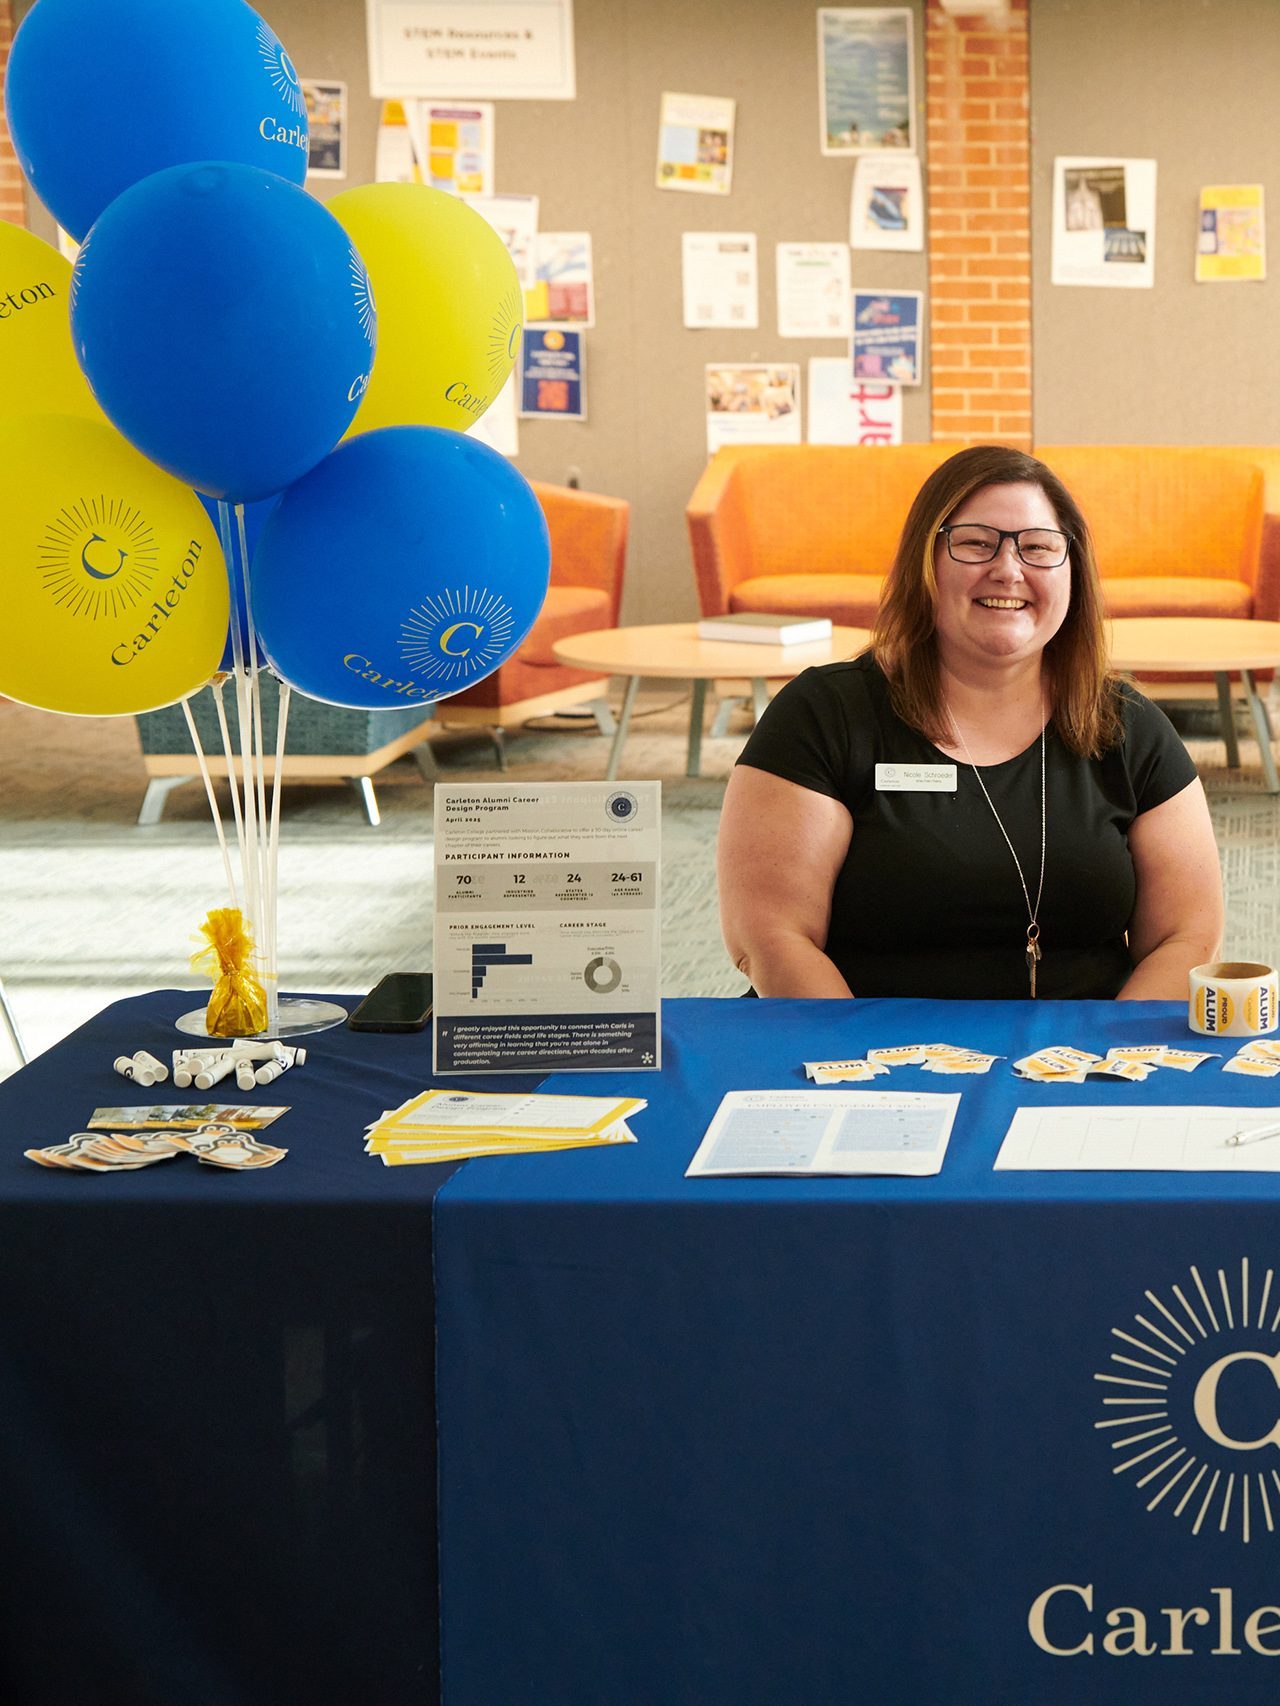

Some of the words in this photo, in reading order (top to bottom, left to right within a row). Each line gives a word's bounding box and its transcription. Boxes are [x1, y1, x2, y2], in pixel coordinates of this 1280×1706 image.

[81, 532, 129, 580] C
[111, 539, 203, 666] Carleton
[439, 622, 484, 658] C
[457, 875, 471, 884] 70
[514, 875, 525, 883] 12
[567, 874, 581, 882] 24
[611, 873, 642, 881] 24-61
[1206, 987, 1216, 1031] ALUM
[1260, 987, 1268, 1030] ALUM
[875, 1046, 920, 1054] ALUM
[1167, 1051, 1205, 1059] ALUM
[817, 1062, 862, 1070] ALUM
[1039, 1057, 1067, 1070] ALUM
